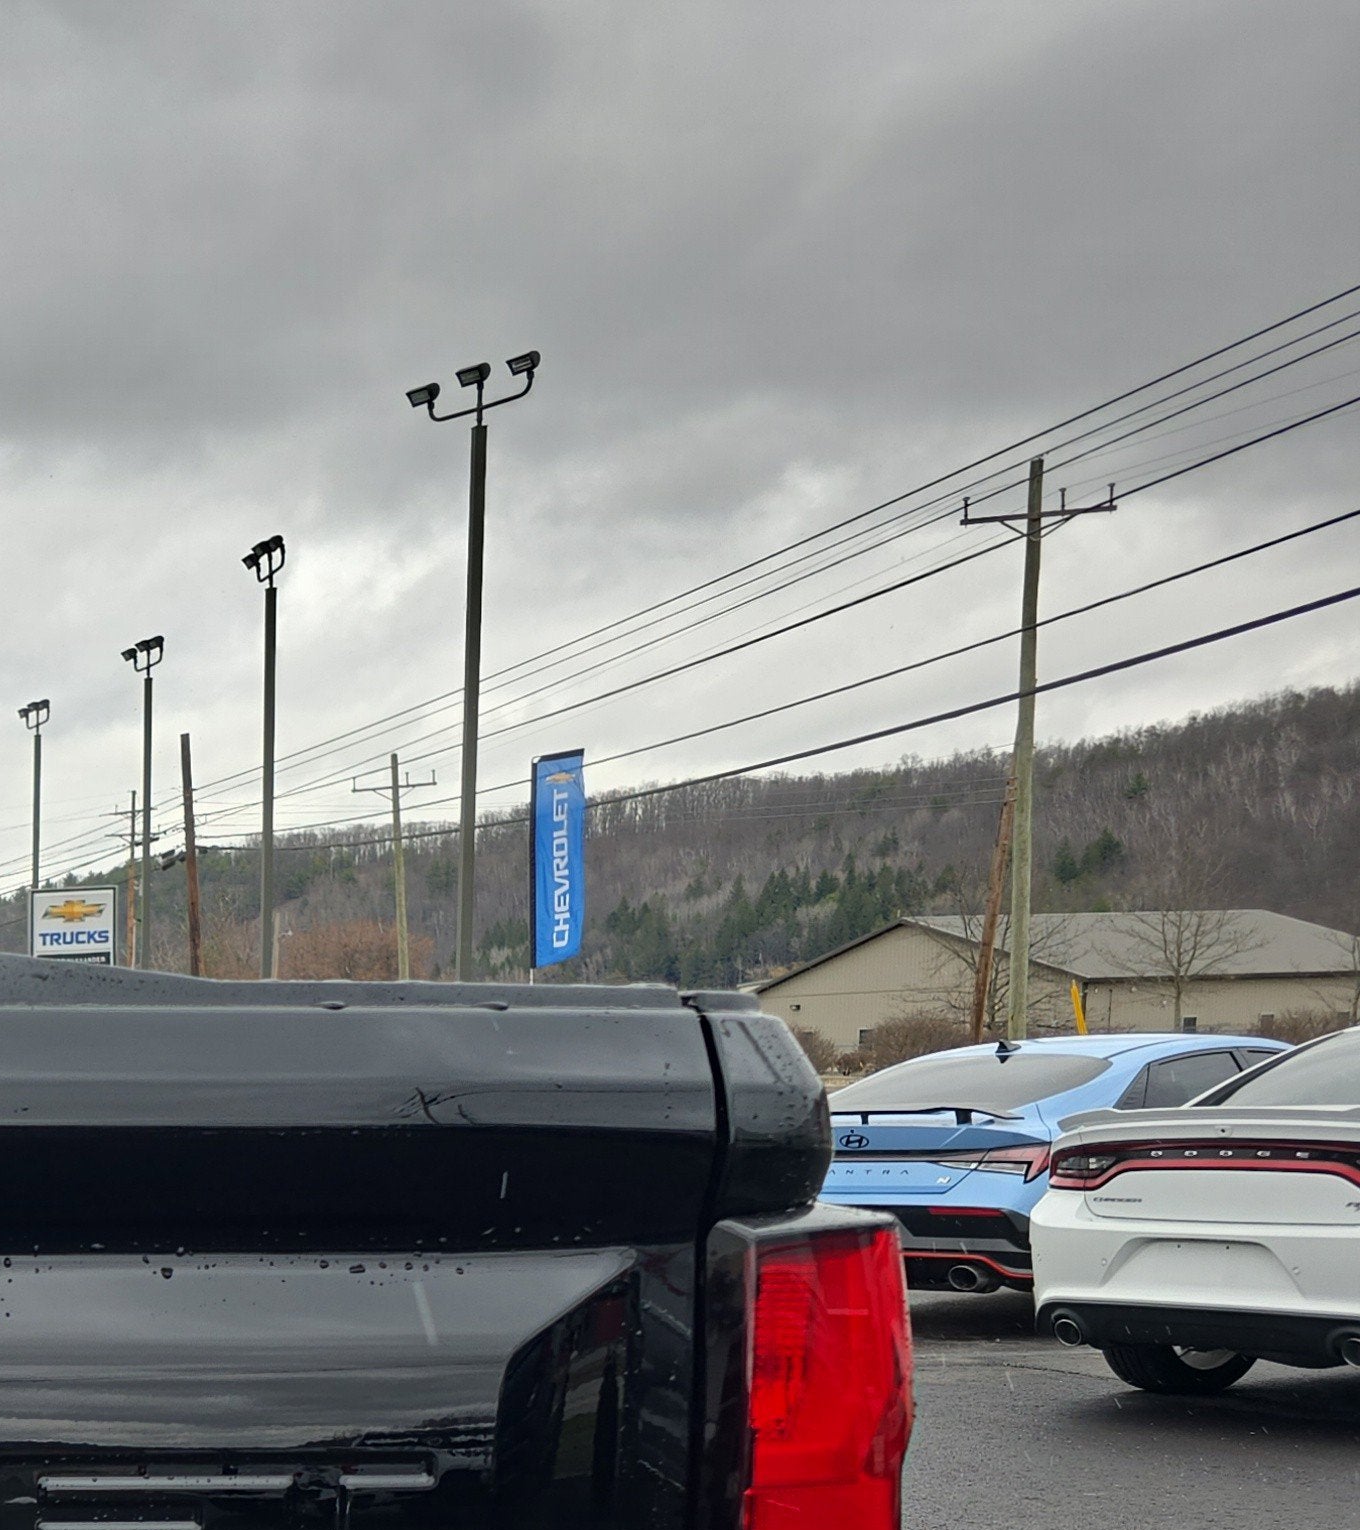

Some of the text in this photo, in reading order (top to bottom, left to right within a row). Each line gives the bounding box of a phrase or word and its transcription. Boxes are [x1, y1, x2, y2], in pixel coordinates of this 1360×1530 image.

[553, 788, 570, 948] CHEVROLET
[38, 929, 109, 946] TRUCKS
[829, 1168, 909, 1176] ANTRA
